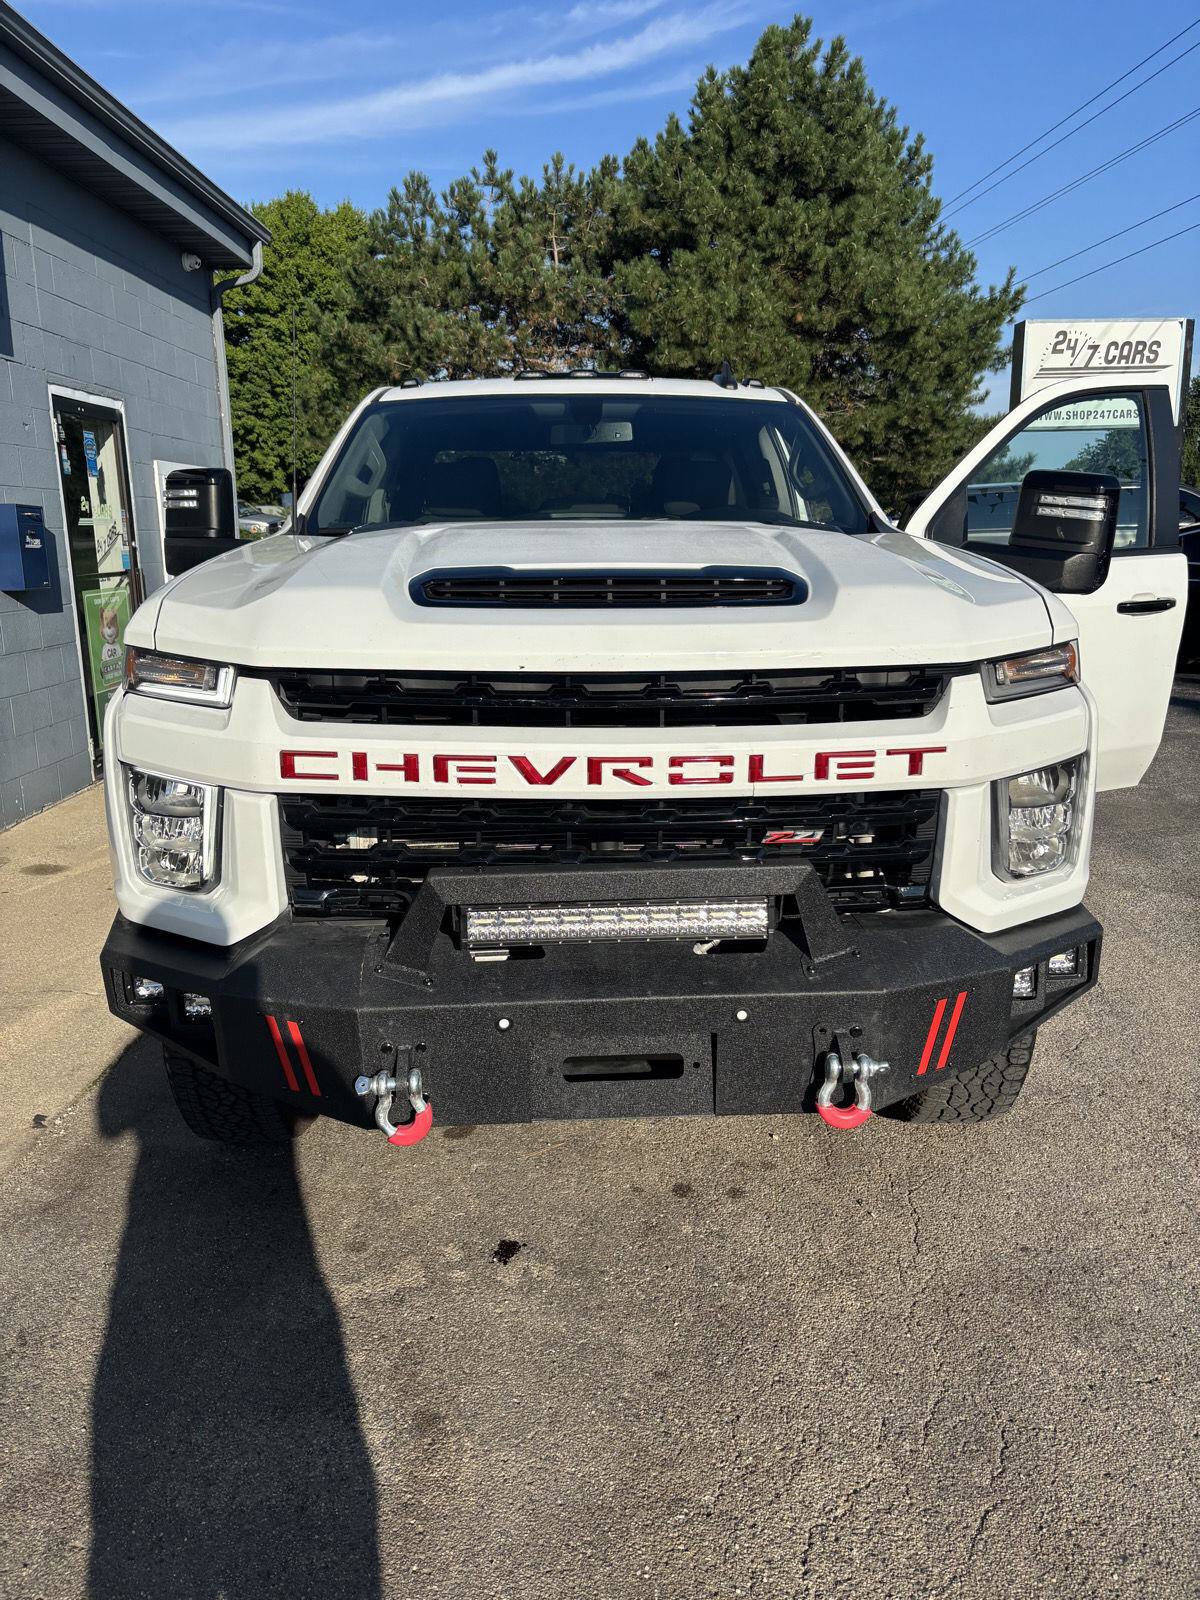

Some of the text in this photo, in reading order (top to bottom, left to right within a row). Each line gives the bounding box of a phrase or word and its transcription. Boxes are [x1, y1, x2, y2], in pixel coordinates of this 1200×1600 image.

[1051, 330, 1162, 368] 24/7 CARS
[1035, 409, 1139, 421] WW.SHOP247CARS
[280, 747, 947, 786] CHEVROLET
